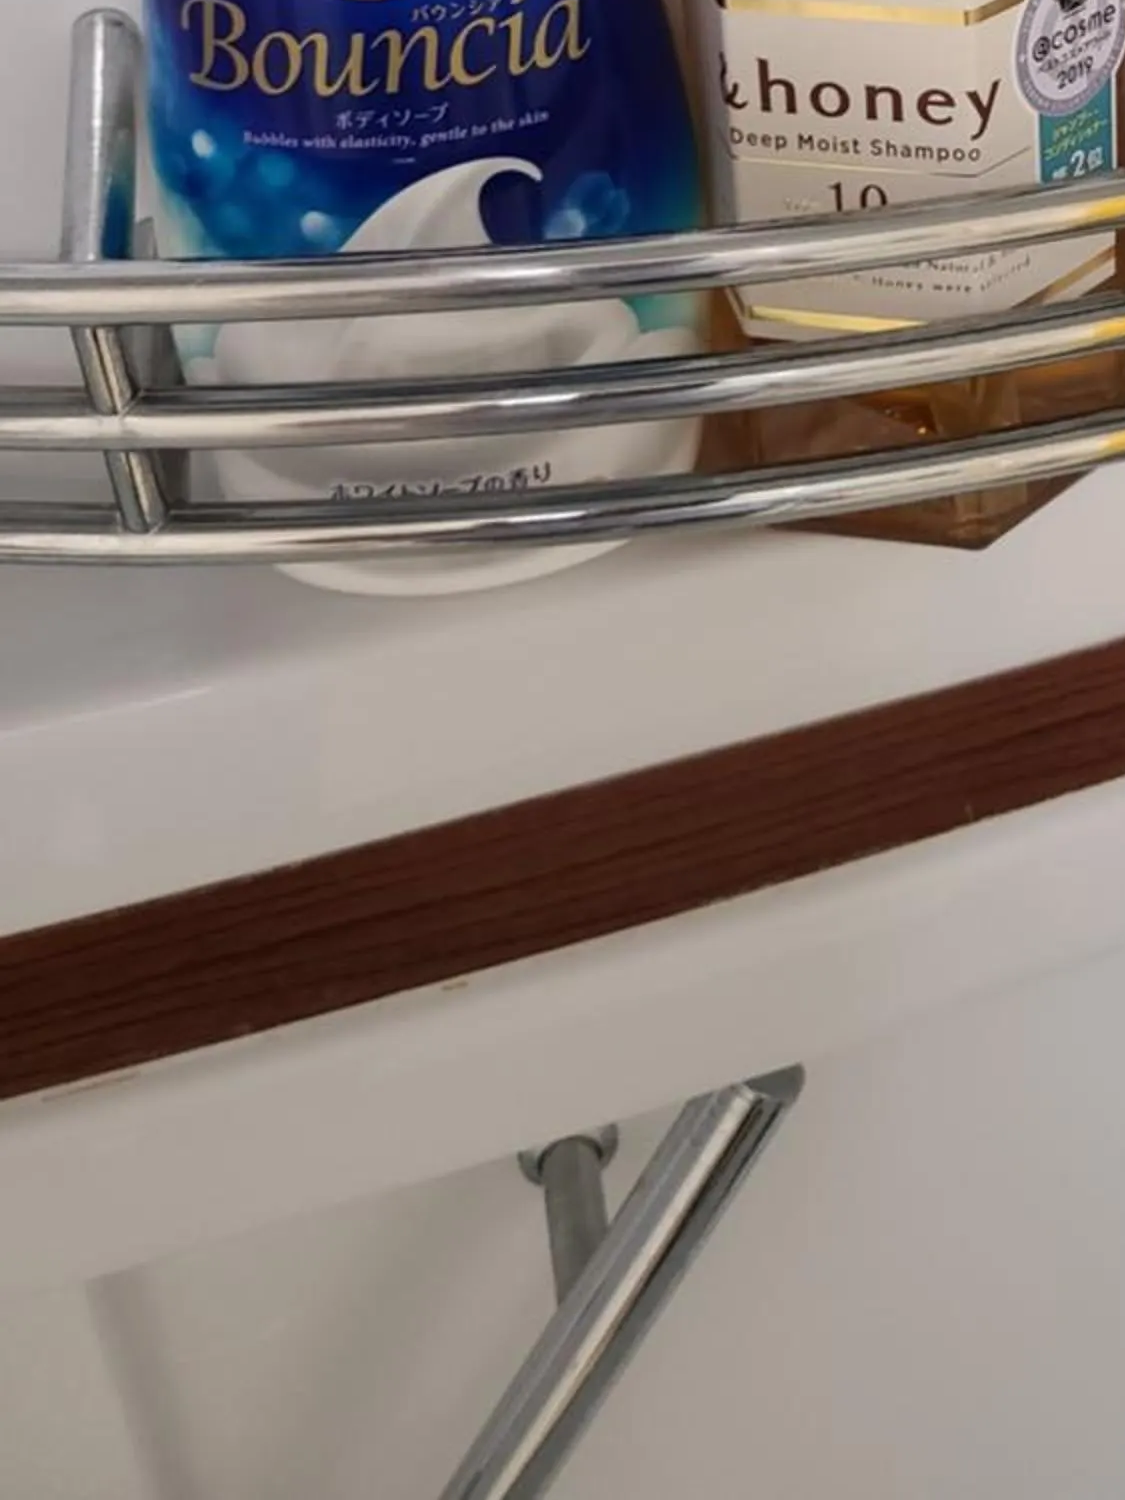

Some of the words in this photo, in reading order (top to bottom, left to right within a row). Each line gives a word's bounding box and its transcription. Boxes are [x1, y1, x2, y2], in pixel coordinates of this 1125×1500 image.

[1032, 3, 1117, 63] @cosme
[1056, 55, 1094, 90] 2019
[243, 130, 299, 149] Bubbles
[303, 132, 337, 149] with
[418, 124, 468, 148] gentle
[470, 121, 488, 137] to
[490, 113, 516, 134] the
[518, 108, 549, 127] skin
[336, 102, 449, 131] ボディソープ
[729, 126, 788, 151] Deep
[798, 133, 861, 156] Moist
[869, 138, 982, 163] Shampoo
